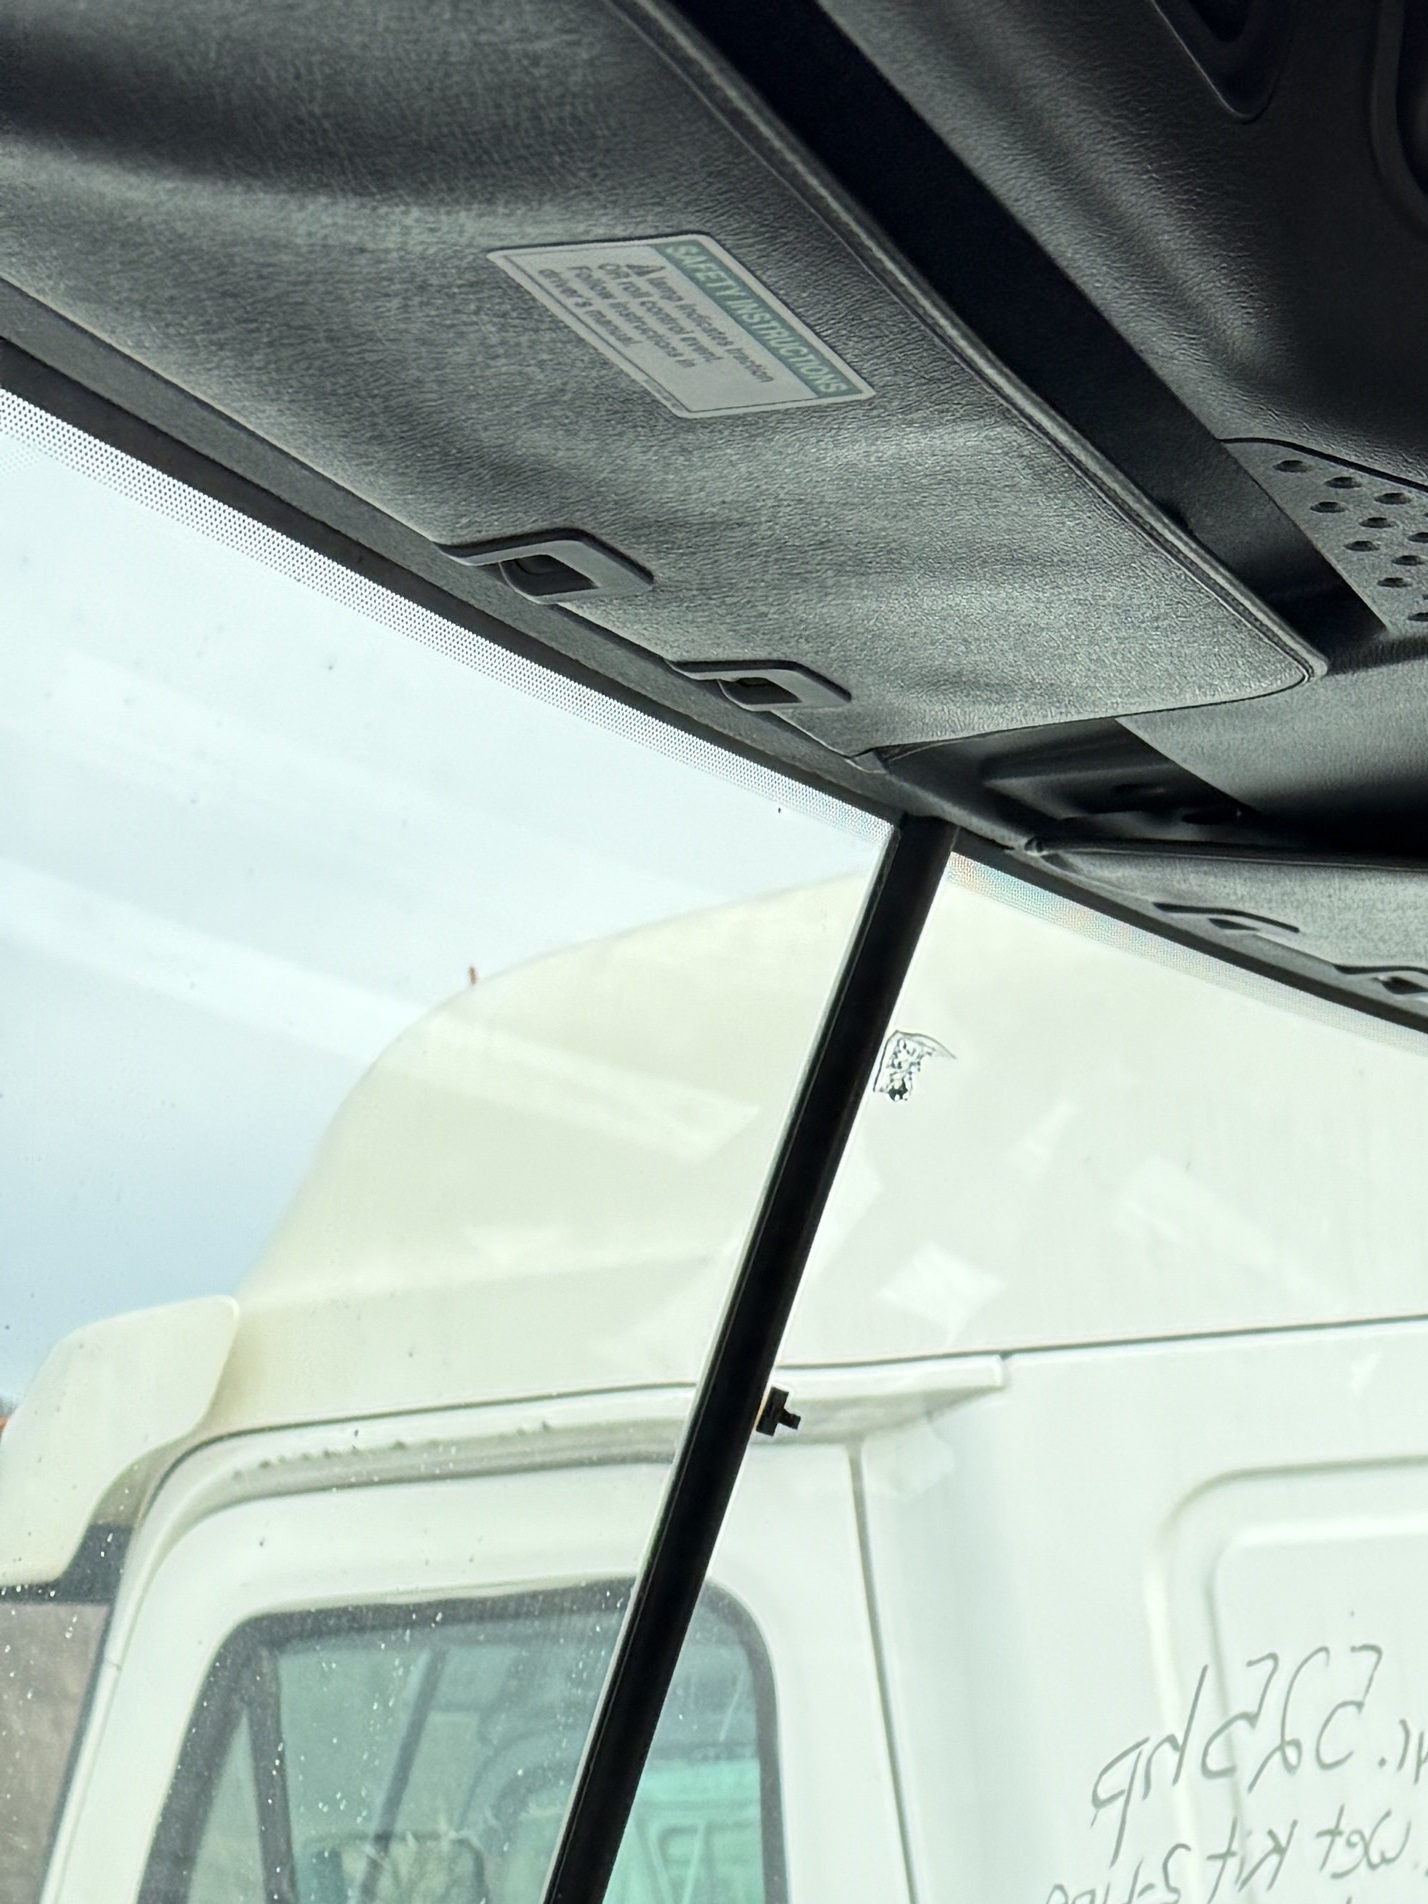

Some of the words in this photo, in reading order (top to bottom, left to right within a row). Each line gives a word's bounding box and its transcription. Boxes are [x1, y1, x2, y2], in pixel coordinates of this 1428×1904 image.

[533, 268, 600, 307] driver's
[565, 265, 624, 300] Follow
[606, 301, 689, 357] instructions
[614, 280, 654, 299] roll
[636, 299, 695, 335] control
[640, 276, 690, 303] lamp
[672, 303, 740, 347] indicates
[723, 347, 779, 382] traction
[661, 244, 748, 298] SAFETY
[724, 298, 850, 393] INSTRUCTIONS
